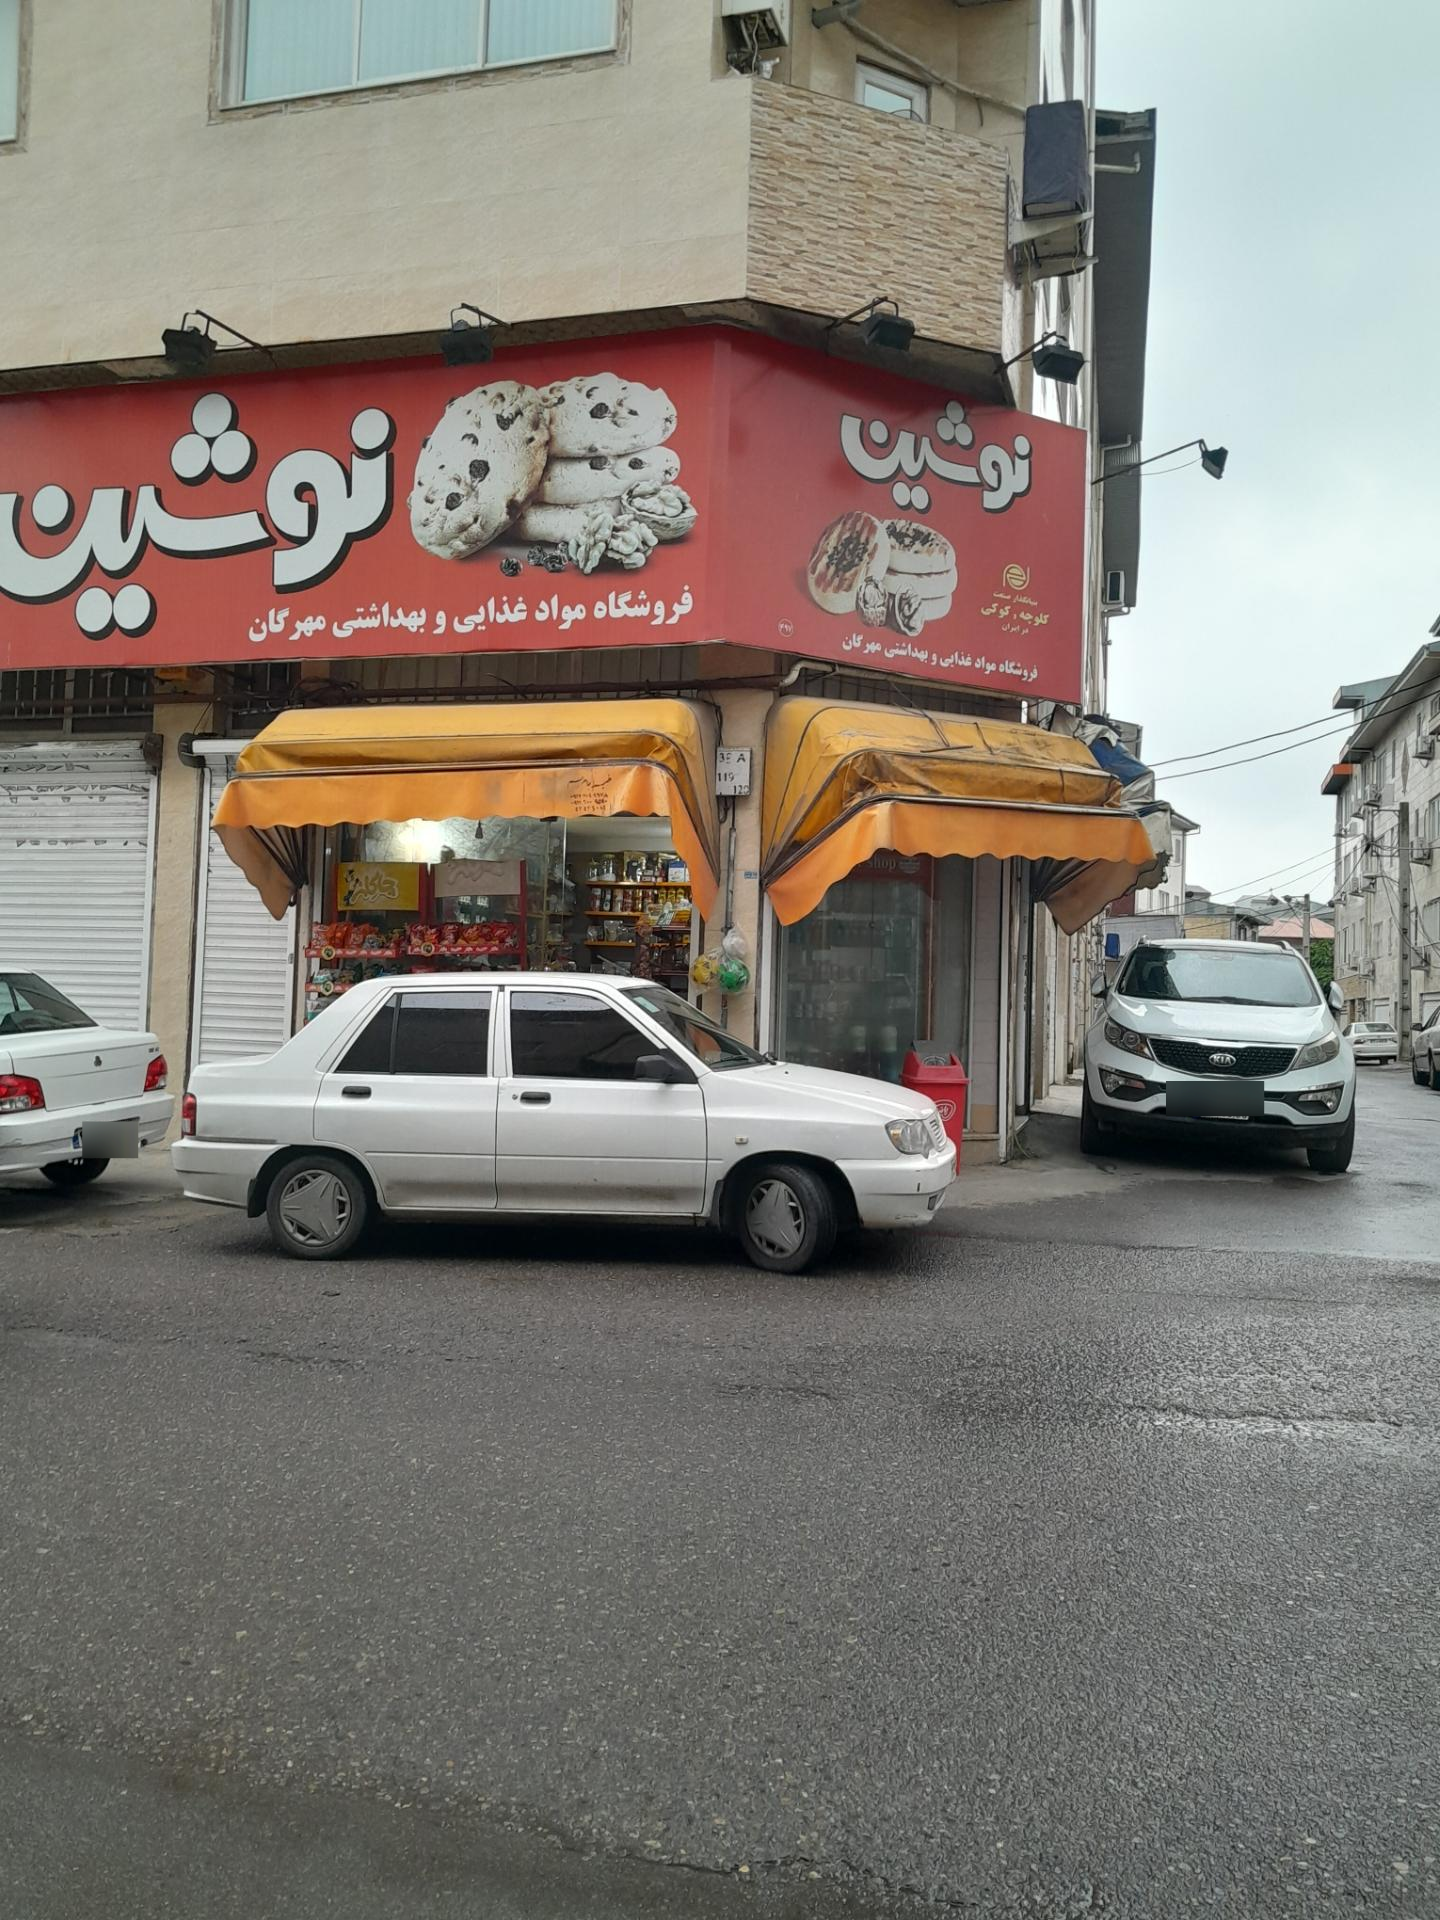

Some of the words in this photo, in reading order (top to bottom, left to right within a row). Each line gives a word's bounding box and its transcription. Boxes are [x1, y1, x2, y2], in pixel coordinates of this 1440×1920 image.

[841, 401, 1031, 512] نوشین
[0, 393, 392, 638] نوشین
[453, 595, 527, 632] غذایی
[535, 594, 586, 629] مواد
[594, 585, 693, 625] فروشگاه
[980, 603, 1012, 619] کوکی
[248, 607, 326, 642] مهرگان
[332, 602, 427, 637] بهداشتی
[433, 610, 446, 634] و
[1001, 622, 1020, 633] ایران
[1019, 612, 1050, 626] کلوچه
[884, 642, 928, 663] بهداشتی
[931, 653, 937, 665] و
[940, 651, 972, 667] غذایی
[974, 656, 997, 674] مواد
[998, 660, 1038, 682] فروشگاه
[736, 753, 746, 763] A
[718, 771, 734, 782] 119
[1211, 1054, 1233, 1066] KIA
